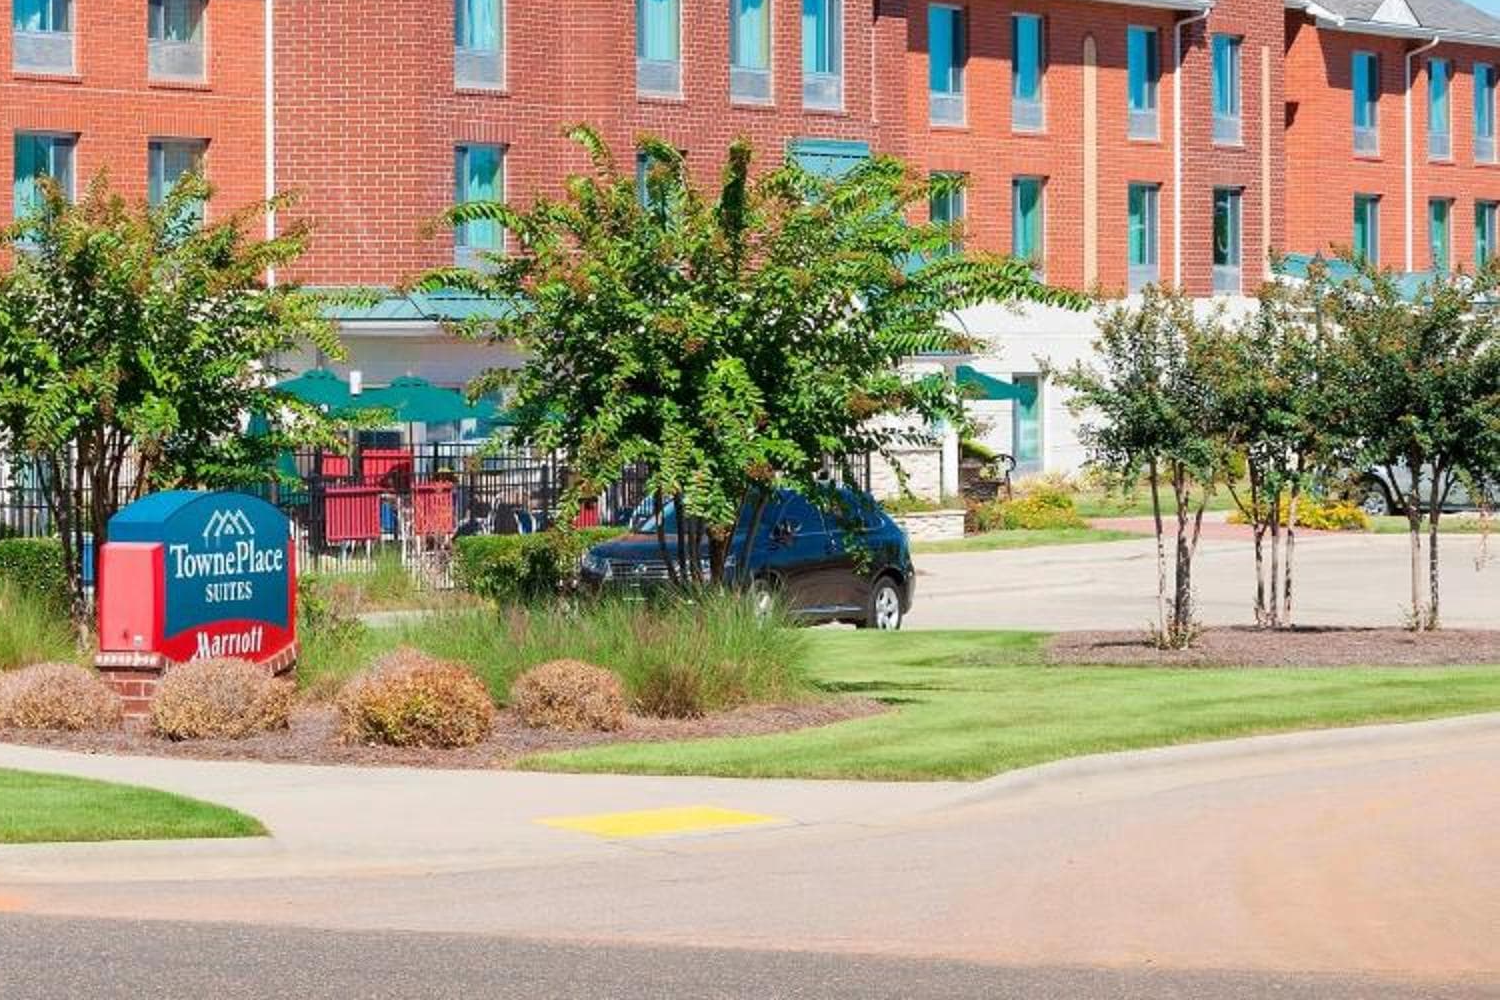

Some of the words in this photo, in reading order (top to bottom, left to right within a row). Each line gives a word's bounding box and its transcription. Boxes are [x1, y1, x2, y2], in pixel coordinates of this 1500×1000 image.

[169, 540, 283, 579] TownePlace
[205, 581, 253, 603] SUITES
[190, 625, 263, 663] Marriott
